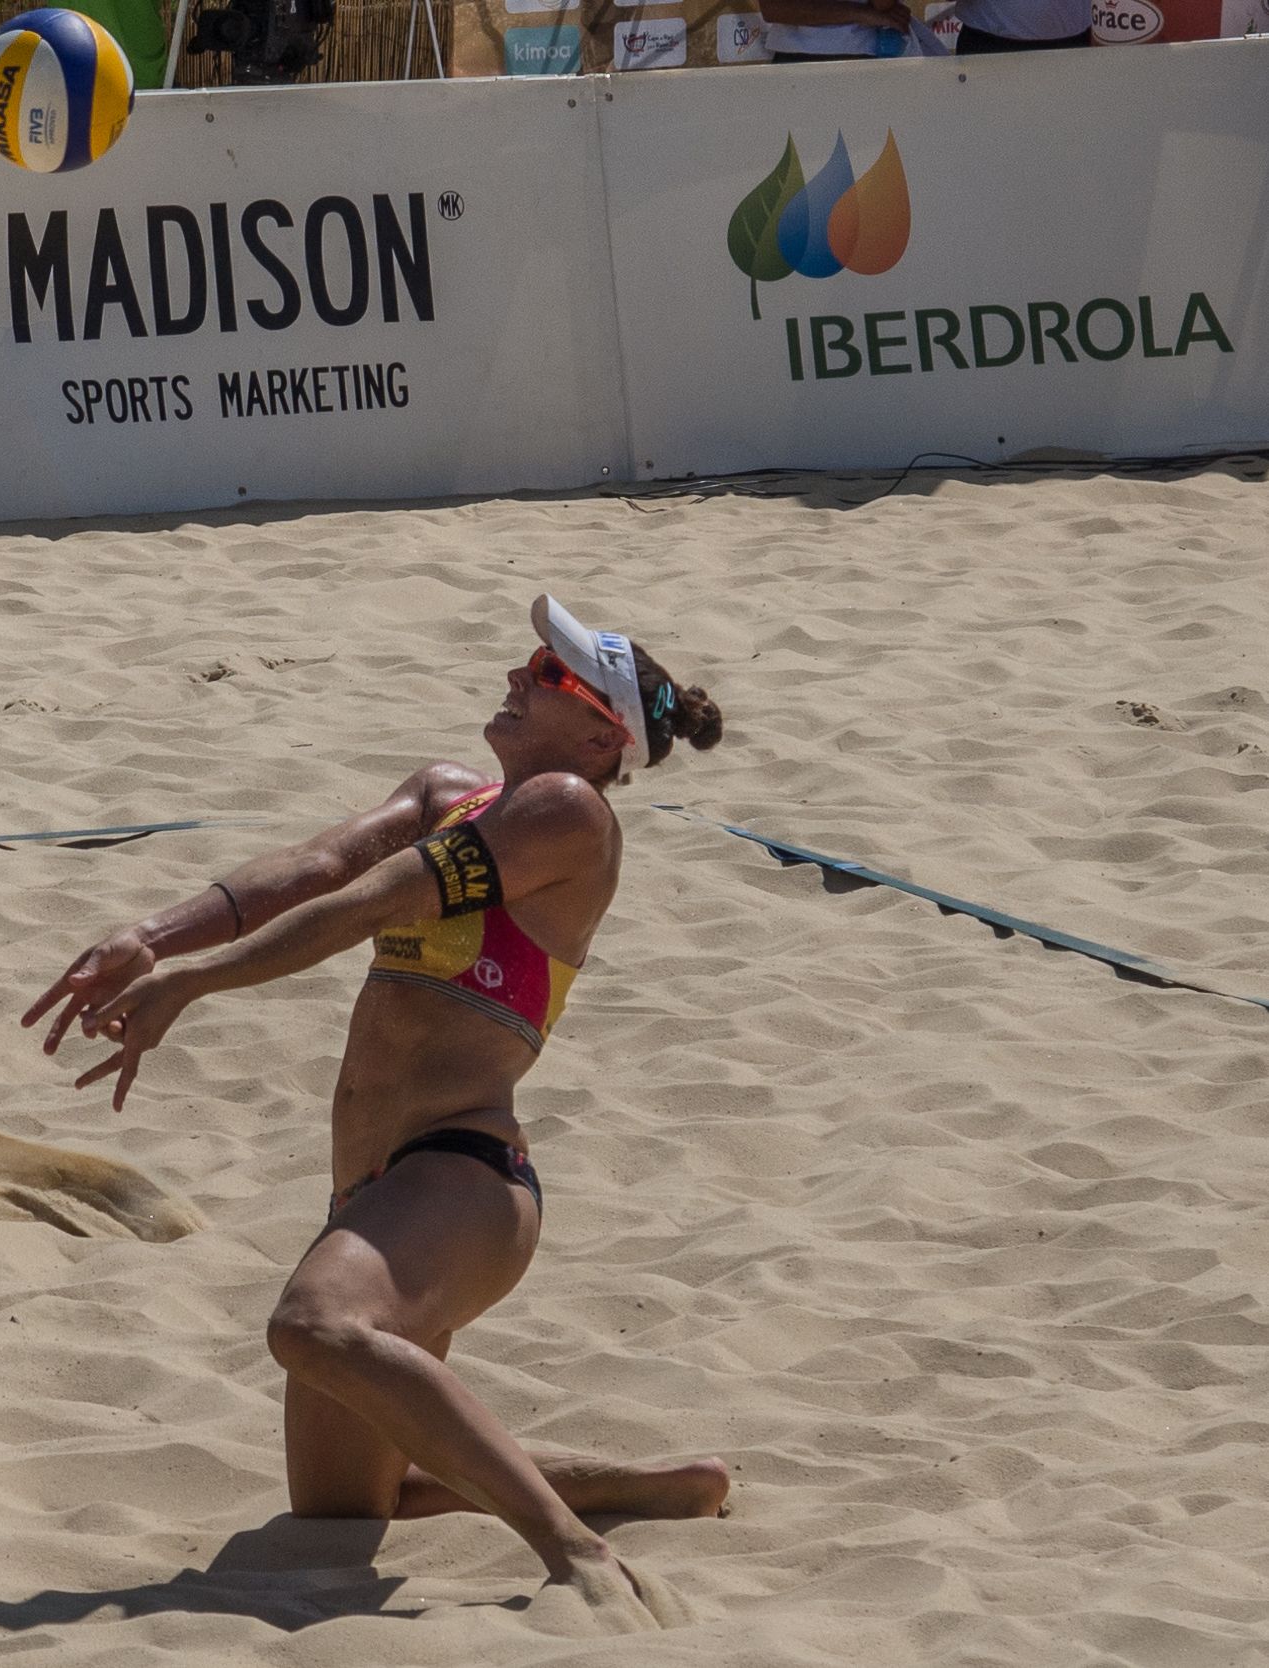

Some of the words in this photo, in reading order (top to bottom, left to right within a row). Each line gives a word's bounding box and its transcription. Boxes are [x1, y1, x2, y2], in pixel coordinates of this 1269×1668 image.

[1091, 4, 1146, 31] Grace
[514, 42, 571, 61] kimoa
[29, 108, 44, 144] FIVB
[7, 192, 435, 343] MADISON
[785, 292, 1234, 381] IBERDROLA
[62, 375, 193, 424] SPORTS
[218, 362, 410, 418] MARKETING
[443, 831, 489, 898] UCAM
